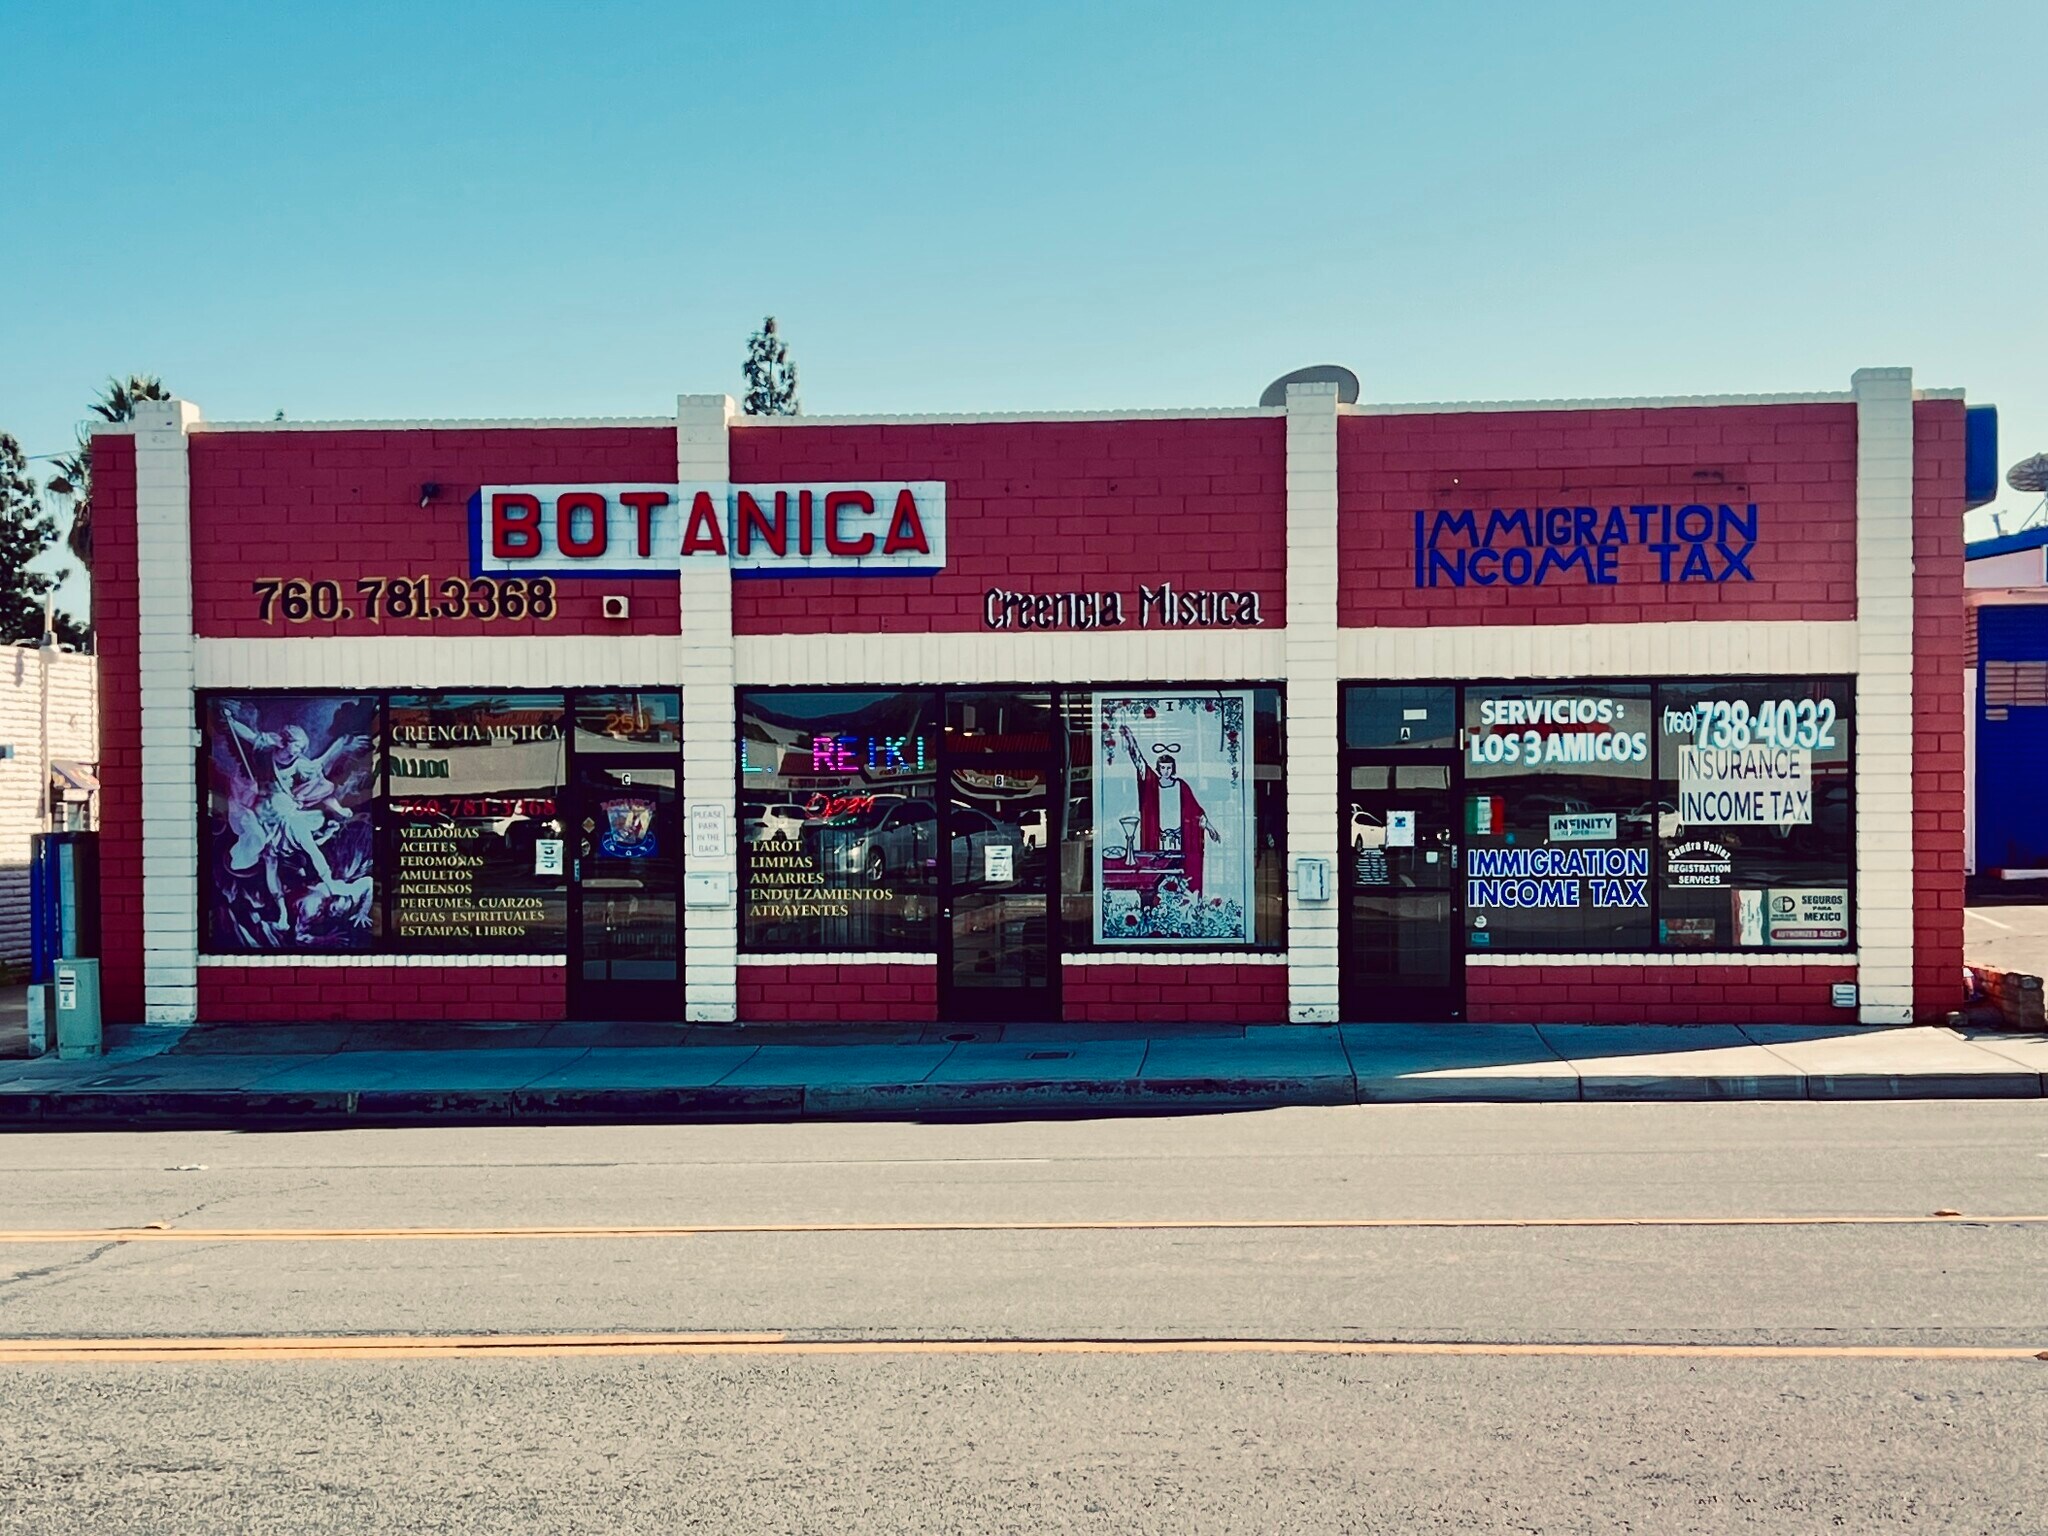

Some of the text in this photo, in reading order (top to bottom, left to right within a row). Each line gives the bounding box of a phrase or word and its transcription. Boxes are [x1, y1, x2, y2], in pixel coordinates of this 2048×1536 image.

[491, 489, 930, 559] BOTANICA
[1415, 503, 1757, 548] IMMIGRATION
[1415, 543, 1755, 588] INCOME TAX
[984, 581, 1265, 630] Creencia Mistica
[1480, 698, 1624, 725] SERVICIOS:
[1663, 704, 1697, 735] (760)
[392, 724, 560, 742] CREENCIA MISTICA
[1401, 728, 1410, 739] A
[812, 735, 925, 772] REIKI
[1470, 731, 1648, 768] LOS 3 AMIGOS
[1681, 748, 1801, 781] INSURANCE
[1681, 790, 1809, 821] INCOME TAX
[698, 822, 719, 830] PARK
[399, 829, 480, 839] VELADORAS
[399, 842, 457, 853] ACEITES
[750, 840, 802, 853] TAROT
[399, 856, 484, 866] FEROMONAS
[750, 855, 813, 869] LIMPIAS
[1467, 848, 1649, 878] IMMIGRATION
[399, 869, 473, 881] AMULETOS
[1667, 864, 1732, 873] REGISTRATION
[750, 872, 825, 884] AMARRES
[1678, 875, 1721, 884] SERVICES
[399, 883, 473, 894] INCIENSOS
[750, 888, 894, 901] ENDULZAMIENTOS
[1467, 879, 1649, 908] INCOME TAX
[399, 897, 543, 910] PERFUMES, CUARZOS
[1801, 895, 1843, 905] SEGUROS
[399, 910, 545, 922] AGUAS ESPIRITUALES
[750, 904, 849, 917] ATRAYENTES
[1803, 912, 1841, 921] MEXICO
[399, 925, 526, 937] ESTAMPAS, LIBROS
